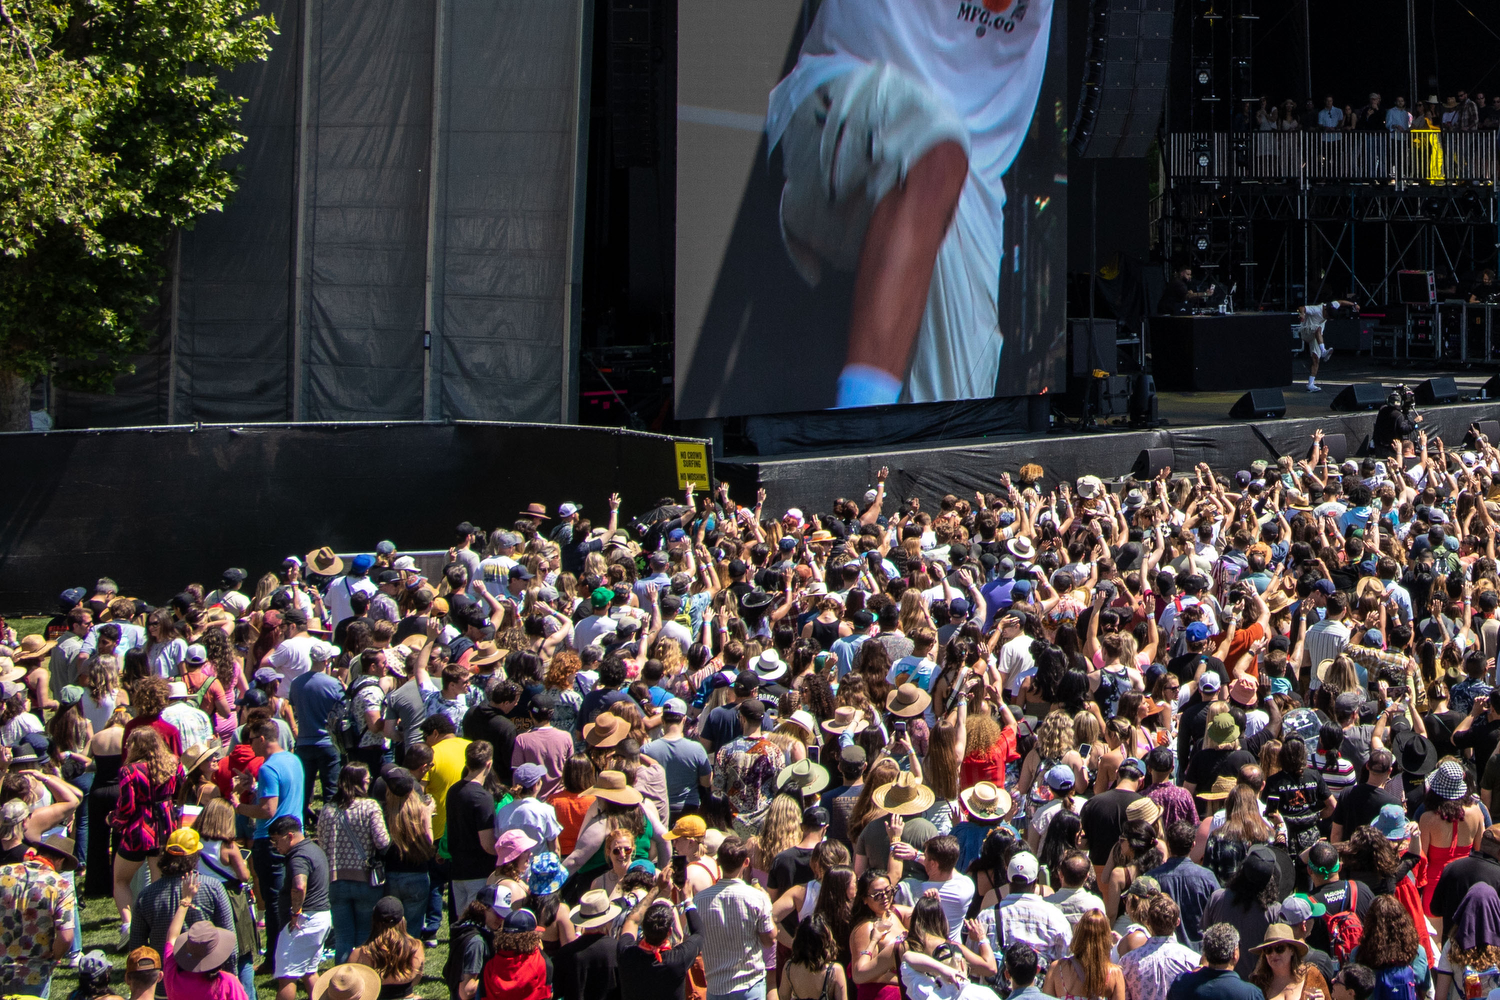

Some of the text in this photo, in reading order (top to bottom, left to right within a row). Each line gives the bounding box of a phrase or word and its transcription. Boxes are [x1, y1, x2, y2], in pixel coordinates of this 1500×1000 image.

[680, 451, 702, 460] NO CROWD
[683, 460, 701, 468] SURFING
[680, 473, 706, 481] NO MOSHING
